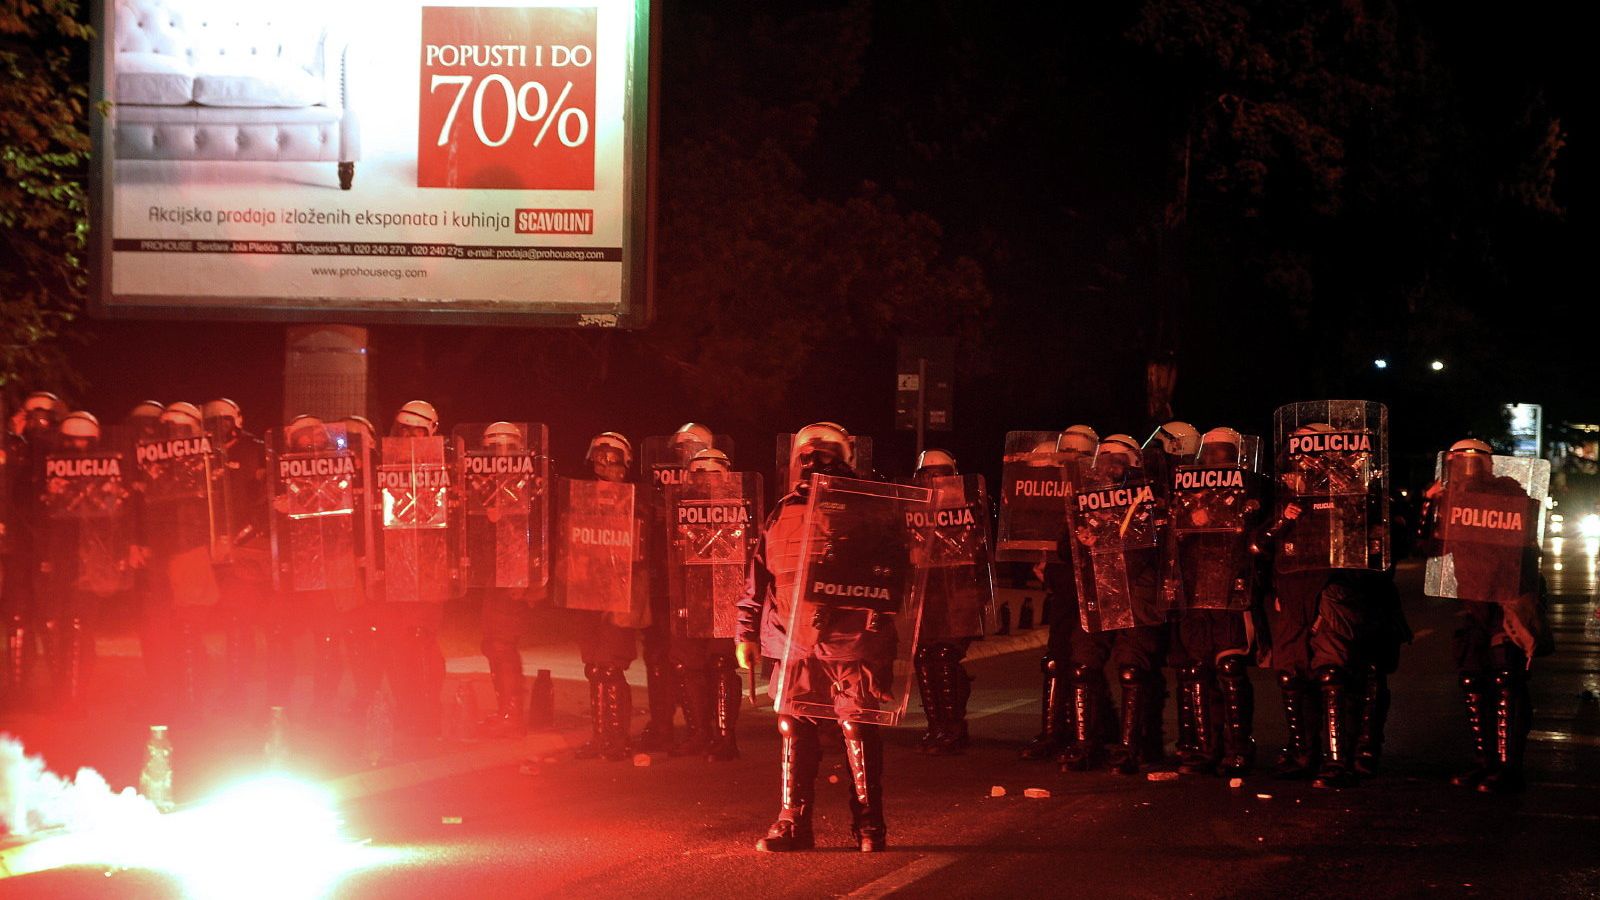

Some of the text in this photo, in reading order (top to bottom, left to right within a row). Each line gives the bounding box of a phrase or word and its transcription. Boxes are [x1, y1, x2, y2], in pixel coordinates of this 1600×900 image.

[426, 45, 592, 66] POPUSTI I DO
[430, 73, 589, 148] 70%
[149, 206, 510, 232] Akcijska prodaja izloženih eksponata i kuhinja
[518, 212, 591, 232] SCAVOLINI
[141, 240, 193, 251] PROHOUSE
[296, 243, 337, 256] Podgorica
[354, 244, 371, 254] 020
[372, 245, 387, 254] 240
[411, 246, 428, 255] 020
[429, 246, 446, 256] 240
[447, 247, 464, 257] 275
[496, 249, 605, 261] prodaja@prohousecg.com
[311, 266, 428, 279] www.prohousecg.com
[136, 438, 212, 464] POLICIJA
[1289, 435, 1372, 454] POLICIJA
[46, 459, 121, 477] POLICIJA
[280, 457, 355, 478] POLICIJA
[464, 456, 534, 474] POLICIJA
[377, 470, 451, 488] POLICIJA
[1016, 480, 1073, 497] POLICIJA
[1175, 470, 1244, 489] POLICIJA
[1078, 485, 1155, 511] POLICIJA
[678, 506, 749, 523] POLICIJA
[905, 508, 975, 527] POLICIJA
[1450, 507, 1522, 530] POLICIJA
[572, 527, 632, 546] POLICIJA
[813, 581, 890, 600] POLICIJA
